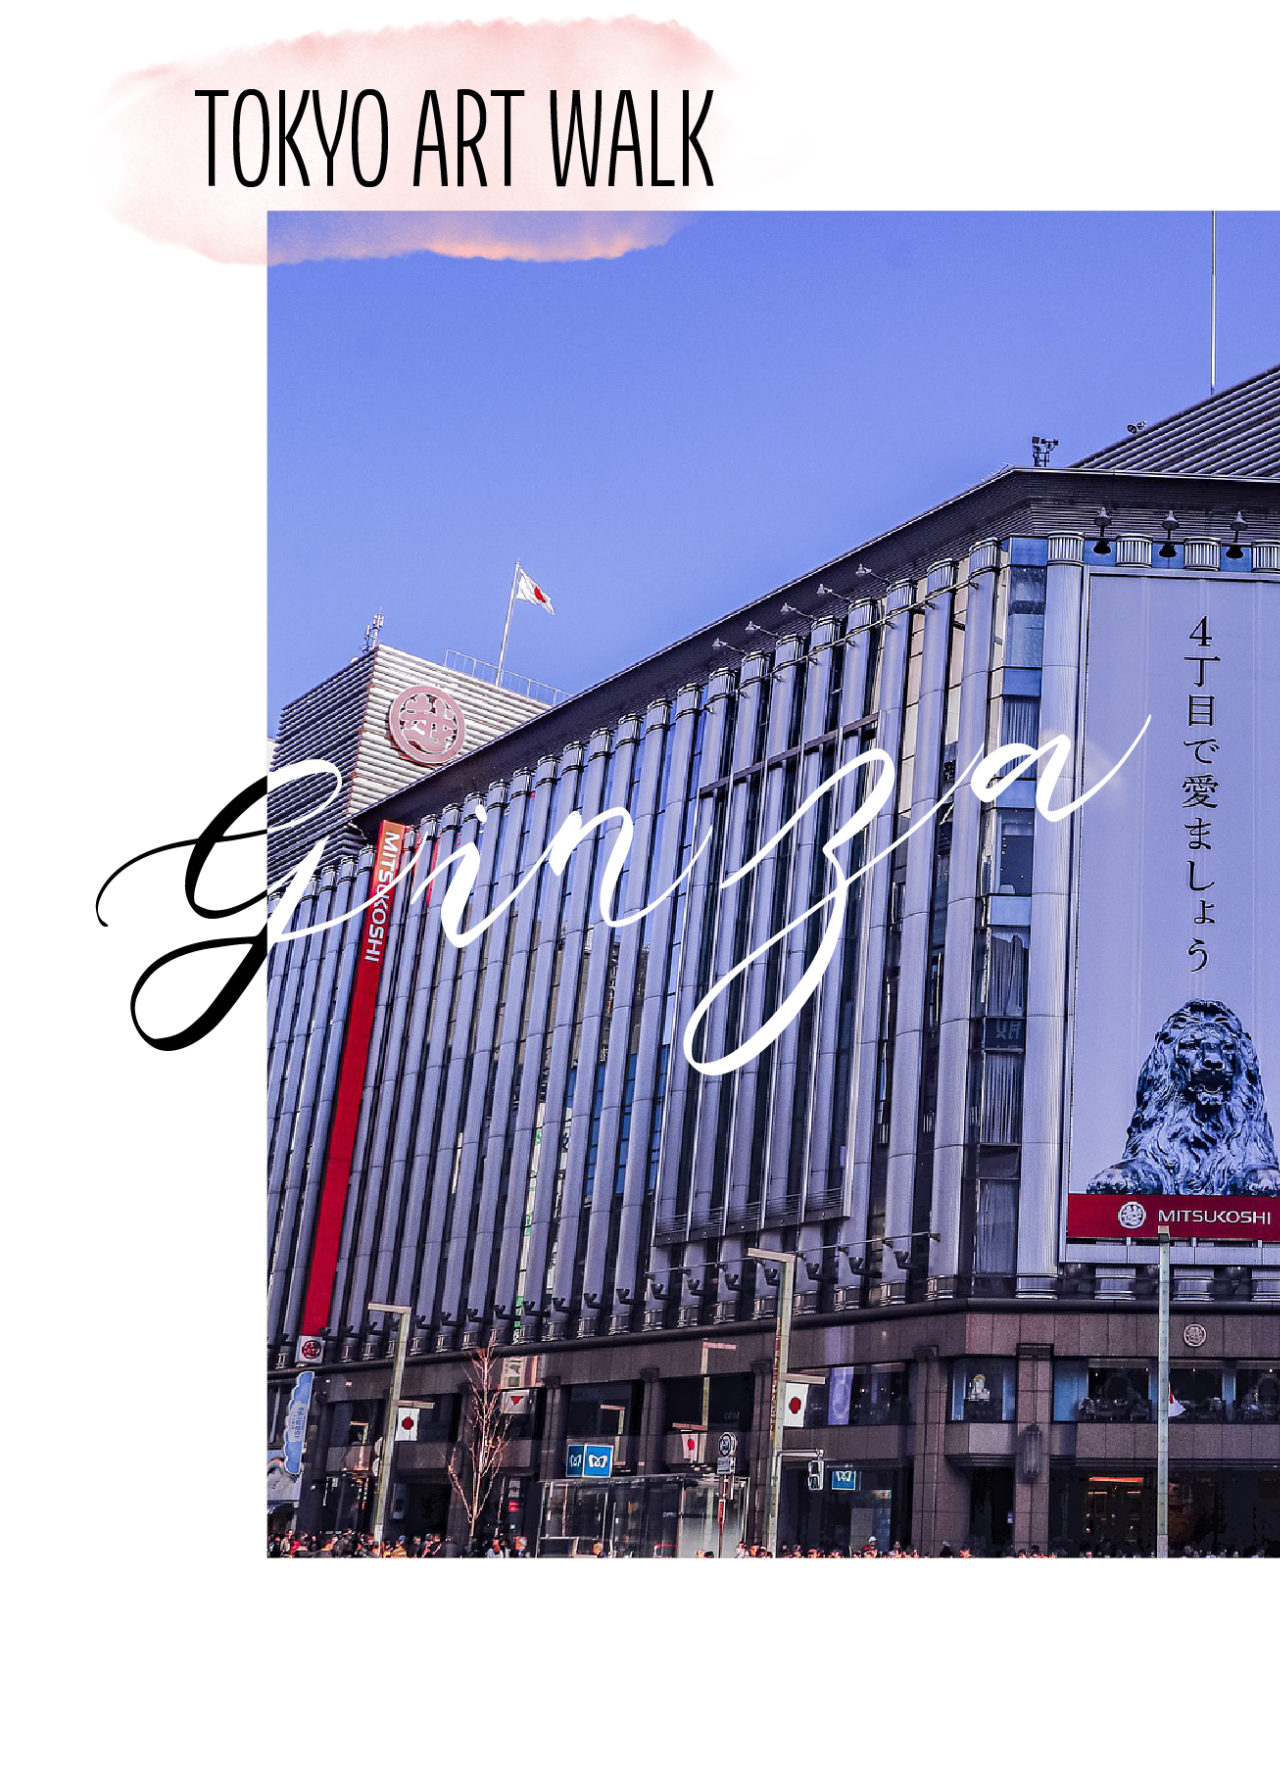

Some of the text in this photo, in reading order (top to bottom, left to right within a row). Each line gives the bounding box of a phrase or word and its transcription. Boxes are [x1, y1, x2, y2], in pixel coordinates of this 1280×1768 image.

[1182, 616, 1221, 972] 4丁目で愛ましょう
[1158, 1210, 1271, 1225] MITSUKOSHI
